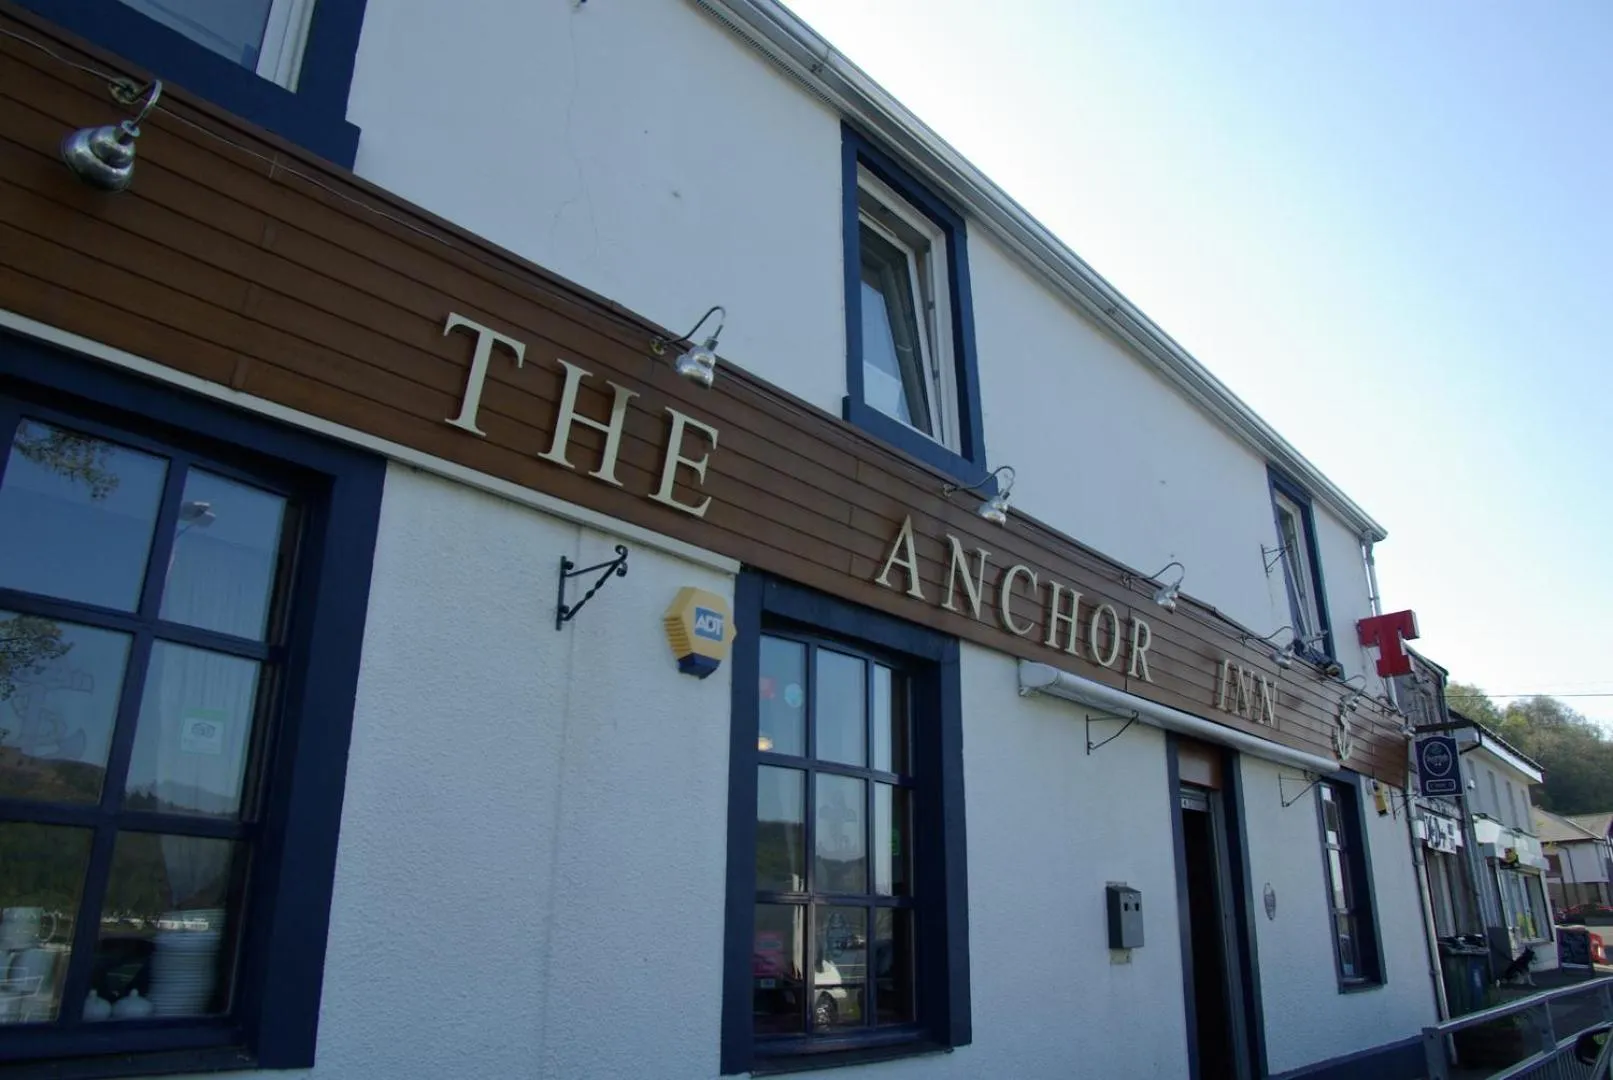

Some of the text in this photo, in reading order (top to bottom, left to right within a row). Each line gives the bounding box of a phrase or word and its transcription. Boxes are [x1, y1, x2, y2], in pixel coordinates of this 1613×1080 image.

[443, 312, 1280, 727] THE ANCHOR INN
[695, 614, 724, 636] ADT
[1357, 609, 1420, 678] T
